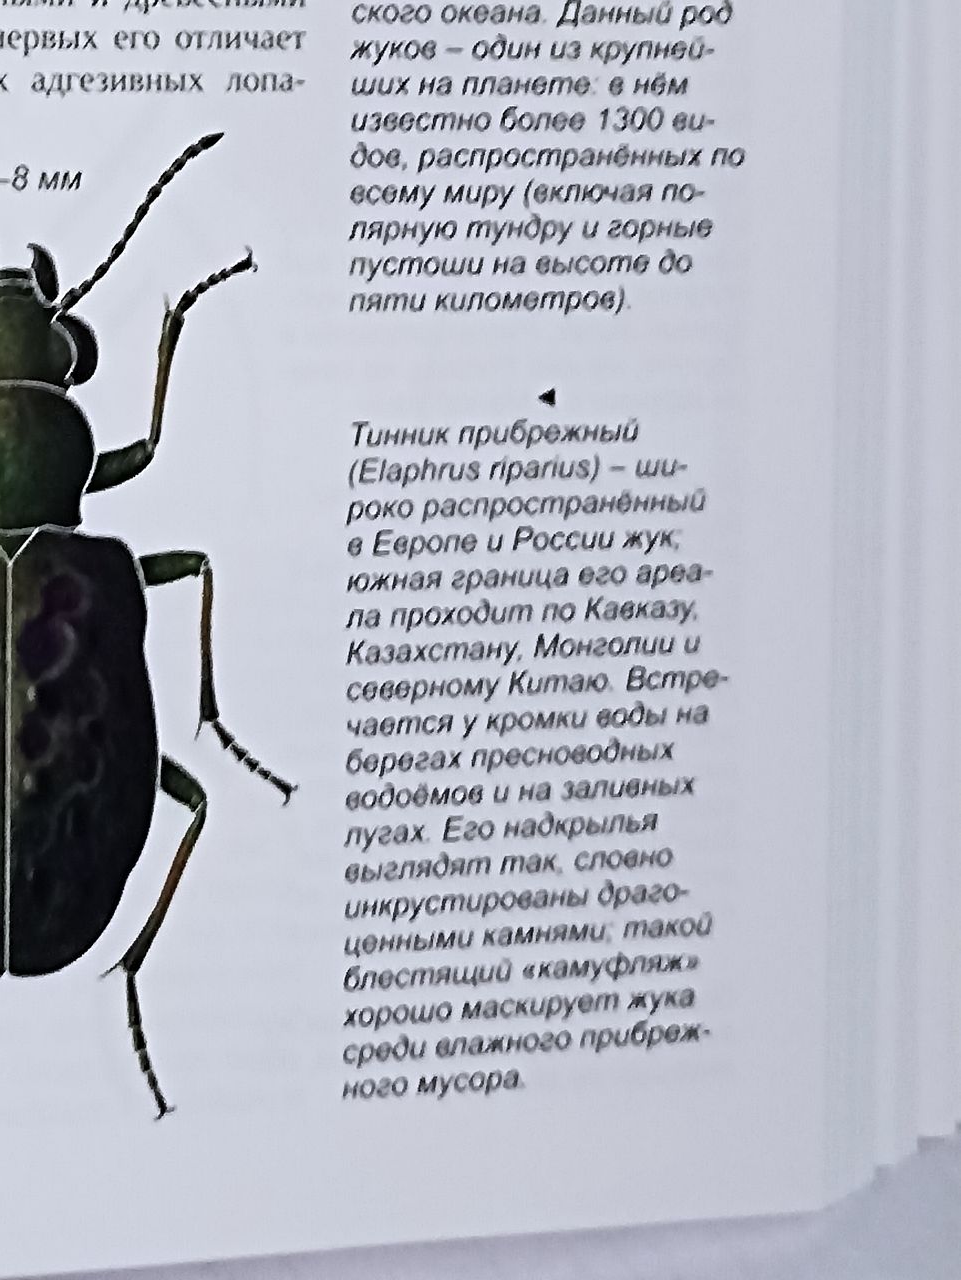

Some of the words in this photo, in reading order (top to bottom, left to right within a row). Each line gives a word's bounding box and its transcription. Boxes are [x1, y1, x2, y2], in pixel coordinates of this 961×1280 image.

[113, 28, 161, 51] его
[174, 28, 308, 51] отличает
[30, 70, 205, 99] адгезивных
[225, 71, 306, 94] лопа-
[350, 75, 412, 97] ших
[417, 74, 454, 97] на
[461, 74, 599, 98] планете:
[607, 74, 625, 97] в
[632, 70, 690, 97] нём
[350, 110, 493, 133] известно
[498, 104, 587, 133] более
[599, 104, 666, 133] 1300
[671, 110, 716, 133] ви-
[349, 140, 408, 172] дов,
[416, 142, 704, 175] распространённых
[710, 146, 747, 169] по
[37, 169, 83, 192] мм
[349, 183, 437, 212] всему
[442, 182, 517, 211] миру
[522, 176, 654, 210] (включая
[660, 181, 706, 204] по-
[347, 218, 458, 248] лярную
[465, 211, 575, 247] тундру
[581, 219, 600, 240] и
[606, 217, 714, 245] горные
[348, 254, 485, 284] пустоши
[491, 254, 527, 276] на
[534, 253, 651, 277] высоте
[657, 247, 694, 276] до
[348, 291, 427, 313] пяти
[434, 285, 632, 317] километров).
[351, 420, 451, 448] Тинник
[457, 416, 640, 451] прибрежный
[344, 497, 415, 528] роко
[420, 486, 707, 525] распространённый
[346, 569, 443, 594] южная
[450, 565, 570, 596] граница
[577, 564, 629, 587] его
[635, 562, 714, 590] ареа-
[345, 637, 523, 667] Казахстану,
[532, 631, 676, 659] Монголии
[683, 634, 702, 655] и
[345, 676, 502, 705] северному
[507, 668, 614, 697] Китаю.
[625, 663, 730, 696] Встре-
[344, 747, 463, 780] берегах
[470, 736, 676, 775] пресноводных
[344, 780, 485, 813] водоёмов
[492, 783, 510, 805] и
[517, 780, 552, 803] на
[560, 775, 696, 803] заливных
[344, 887, 590, 924] инкрустированы
[596, 877, 690, 911] драго-
[342, 957, 513, 994] блестящий
[522, 950, 701, 985] «камуфляж»
[342, 1000, 453, 1032] хорошо
[460, 991, 621, 1022] маскирует
[626, 986, 697, 1017] жука
[342, 1032, 428, 1070] среди
[434, 1029, 574, 1059] влажного
[579, 1018, 712, 1054] прибреж-
[341, 1075, 409, 1101] ного
[415, 1067, 526, 1102] мусора.
